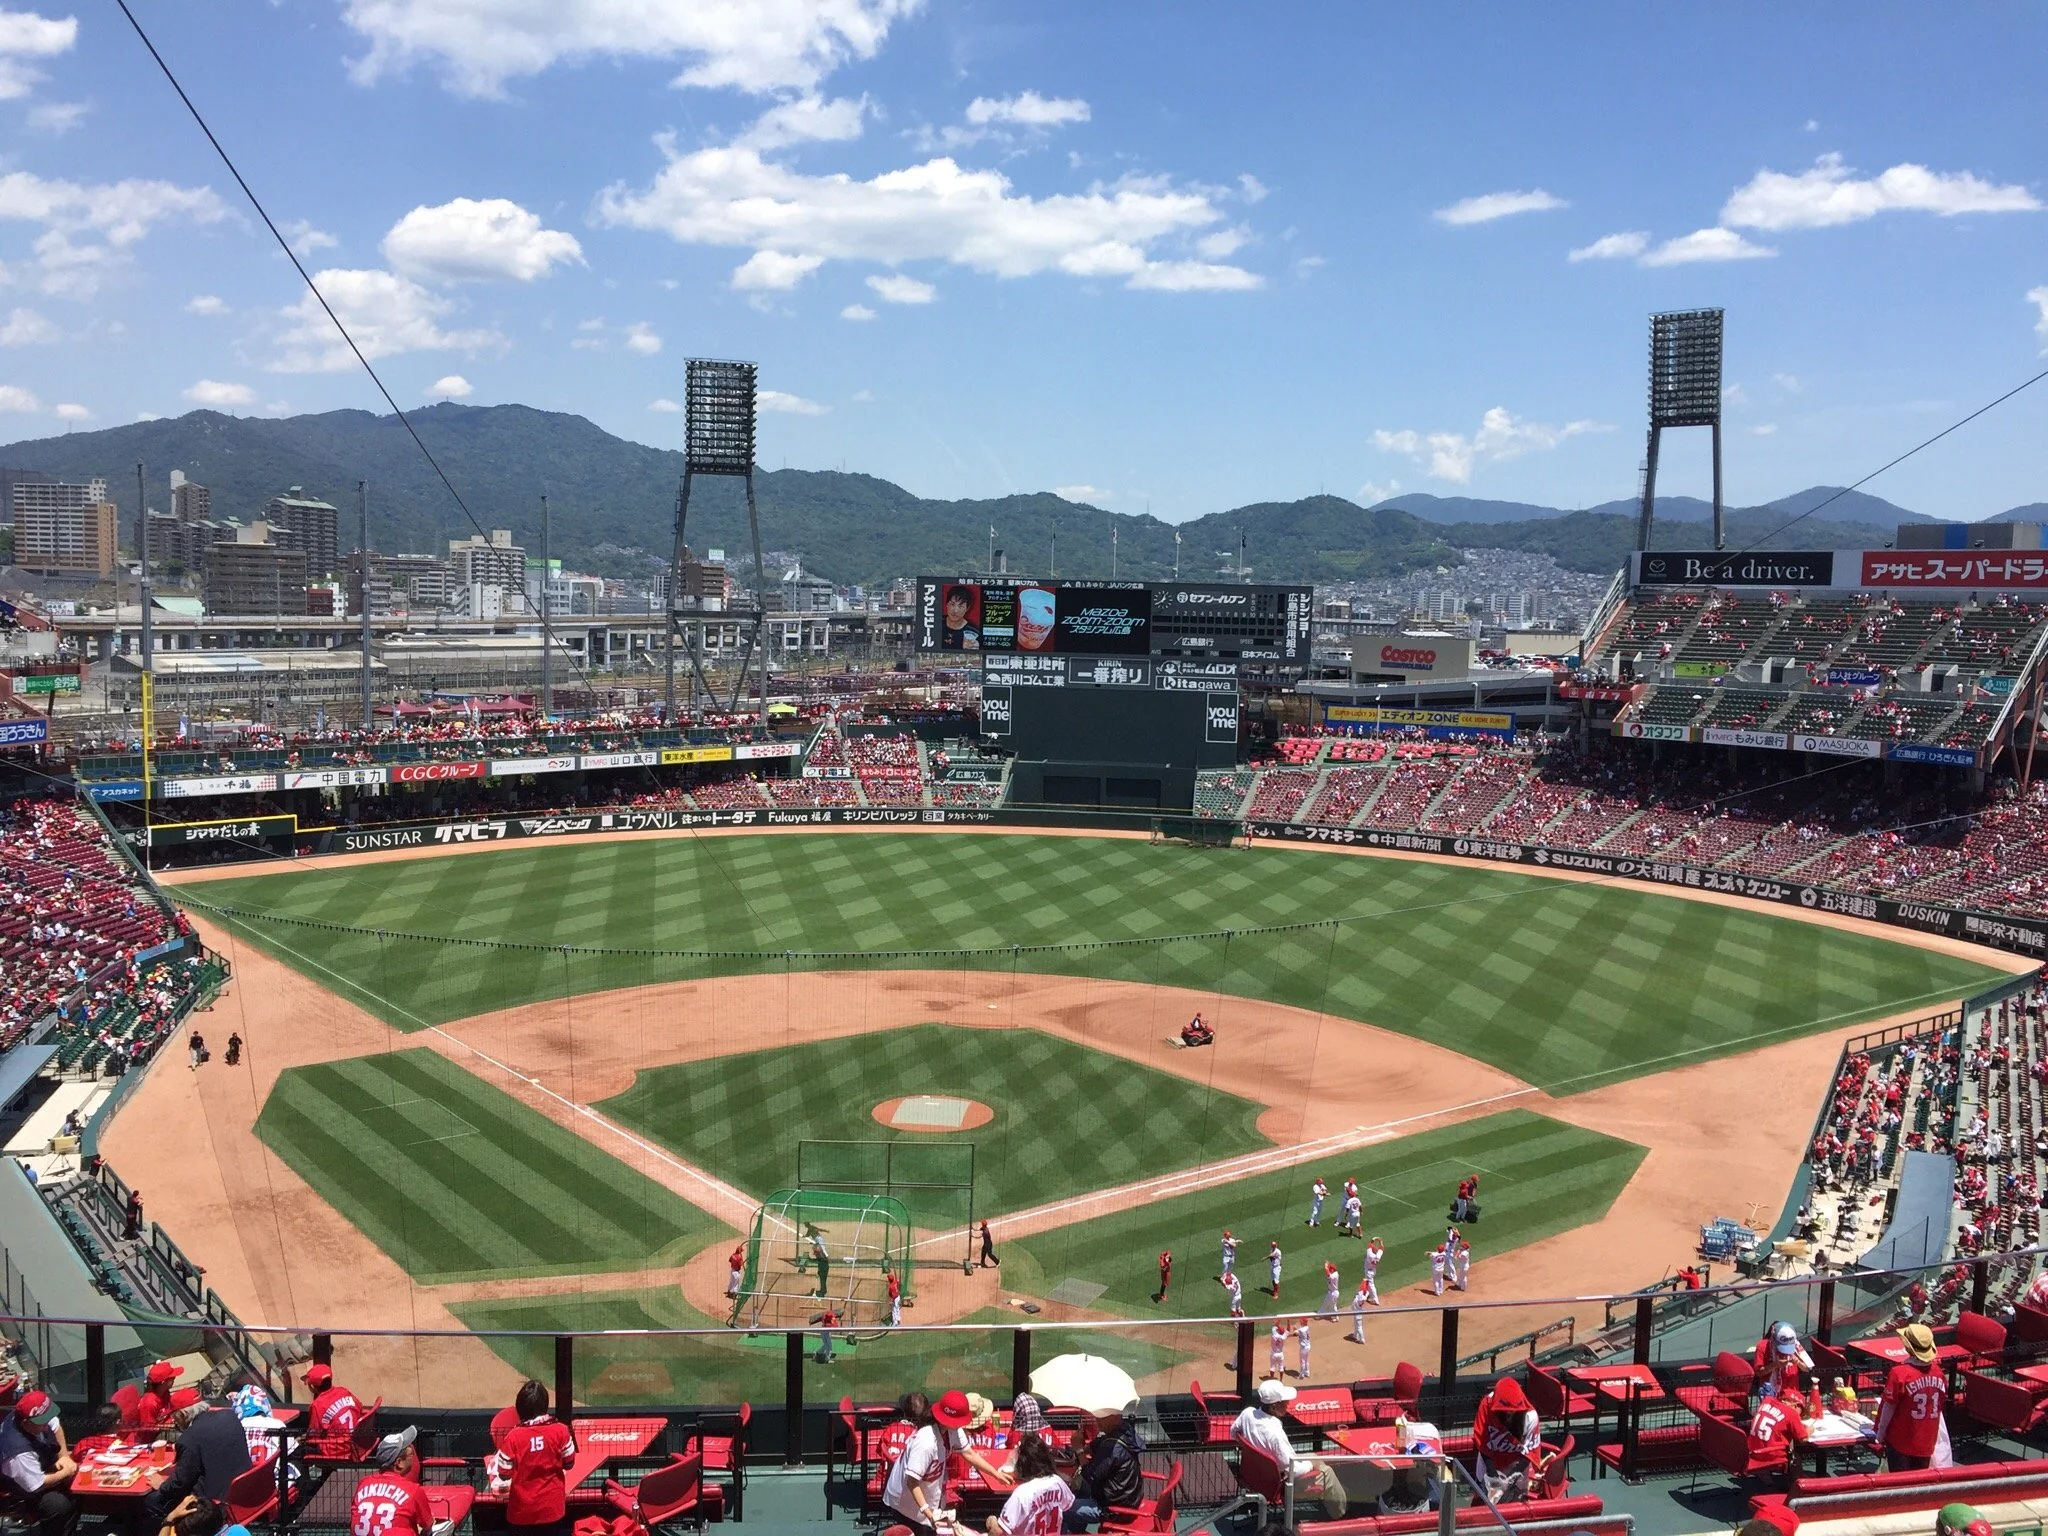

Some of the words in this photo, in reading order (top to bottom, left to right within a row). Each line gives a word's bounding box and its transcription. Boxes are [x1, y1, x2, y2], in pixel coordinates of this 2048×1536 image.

[1684, 558, 1715, 579] Be
[1722, 566, 1734, 580] a
[1741, 558, 1814, 580] driver.
[921, 584, 937, 648] アサヒビール
[1069, 625, 1132, 635] スタジアム広島
[1285, 592, 1299, 658] 広島市信用組合
[1181, 637, 1215, 647] 広島銀行
[1241, 651, 1280, 659] 日本アイコム
[1010, 656, 1066, 671] 東亜地所
[1097, 660, 1122, 668] KIRIN
[1001, 673, 1065, 687] 西川ゴム工業
[1077, 667, 1142, 684] 一番搾り
[1163, 676, 1231, 691] Kitagawa
[982, 699, 1009, 713] you
[1208, 707, 1236, 720] you
[986, 711, 1010, 721] me
[1212, 718, 1236, 729] me
[1381, 710, 1425, 721] エディオン
[1427, 712, 1460, 723] ZONE
[1643, 726, 1684, 739] オタフク
[1734, 731, 1786, 747] もみじ銀行
[1818, 739, 1870, 752] MASUOKA
[558, 759, 572, 768] フジ
[610, 754, 653, 766] 山口銀行
[664, 751, 694, 761] 東洋水産
[322, 768, 382, 785] 中国電力
[400, 763, 479, 782] CGCグループ
[955, 770, 985, 779] 広島ガス
[101, 787, 140, 797] アスカネット
[617, 812, 678, 830] ユウベル
[681, 811, 757, 825] 住まいのトータテ
[768, 811, 808, 824] Fukuya
[811, 811, 832, 822] 福屋
[842, 811, 918, 822] キリンビバレッジ
[947, 812, 995, 822] タカキベーカリー
[185, 821, 261, 841] シマヤだしの素
[434, 820, 508, 843] クマヒラ
[1304, 827, 1363, 843] フマキラー
[345, 830, 422, 850] SUNSTAR
[1380, 834, 1442, 852] 中國新聞
[1468, 841, 1523, 861] 東洋証券
[1551, 853, 1613, 871] SUZUKI
[1635, 862, 1701, 886] 大和興産
[1820, 891, 1878, 919] 五洋建設
[1897, 903, 1951, 926] DUSKIN
[1978, 918, 2047, 949] 章栄不動産
[1906, 1375, 1946, 1396] ISHIHARA
[1295, 1399, 1341, 1412] Coca-Cola
[1910, 1391, 1940, 1420] 31
[338, 1409, 354, 1433] 7
[1750, 1412, 1777, 1442] 15
[529, 1435, 545, 1453] 15
[357, 1482, 410, 1506] KIKUCHI
[1031, 1488, 1064, 1514] SUZUKI
[353, 1501, 397, 1536] 33
[1033, 1504, 1060, 1536] 51
